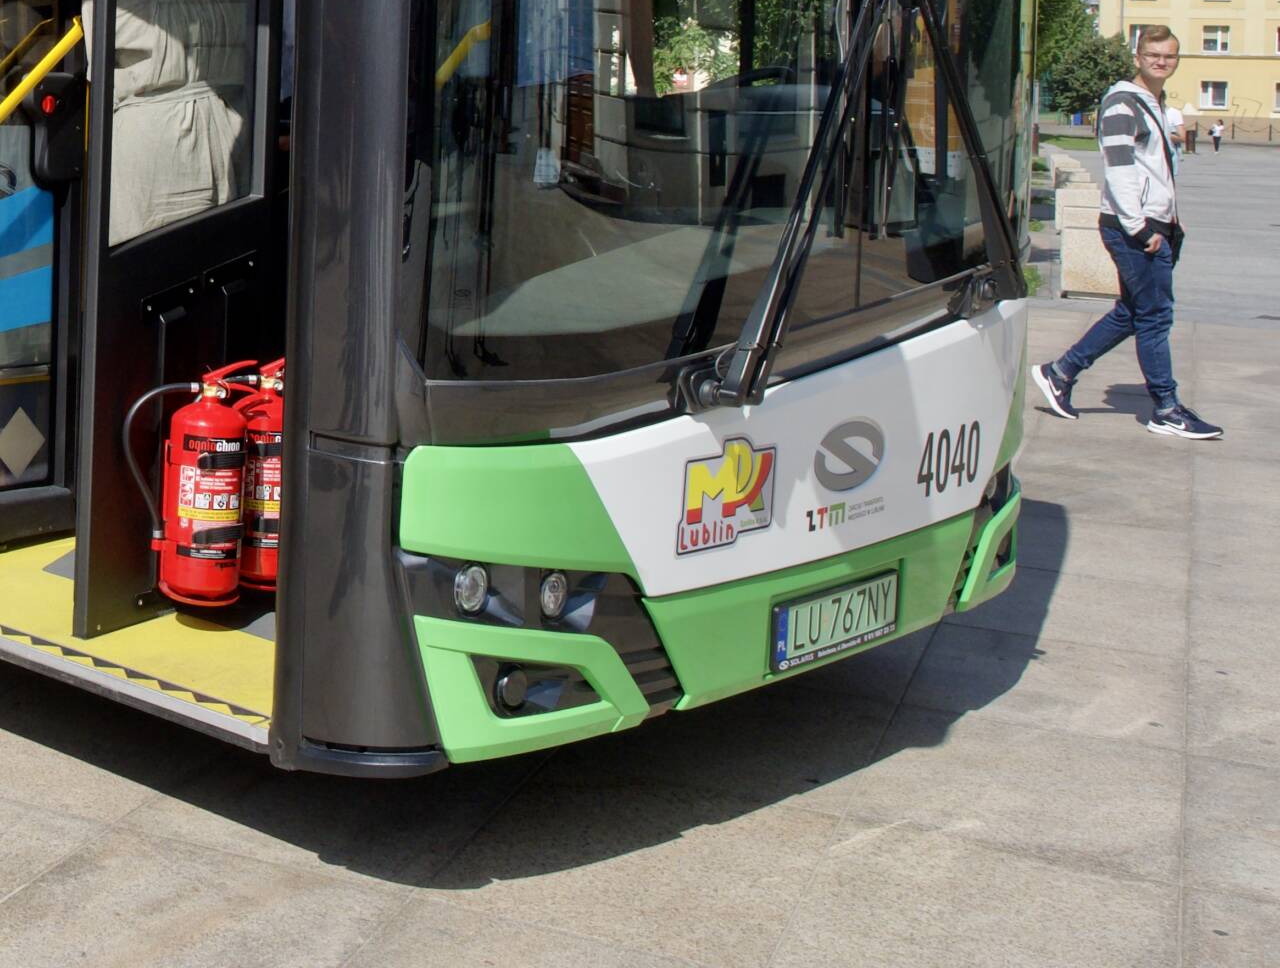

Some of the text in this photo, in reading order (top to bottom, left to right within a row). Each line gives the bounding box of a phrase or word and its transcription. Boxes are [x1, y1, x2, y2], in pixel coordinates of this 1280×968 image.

[917, 421, 980, 497] 4040
[806, 502, 846, 532] ZTM
[680, 520, 734, 551] Lublin
[792, 579, 892, 651] LU 767NY
[777, 640, 787, 652] PL
